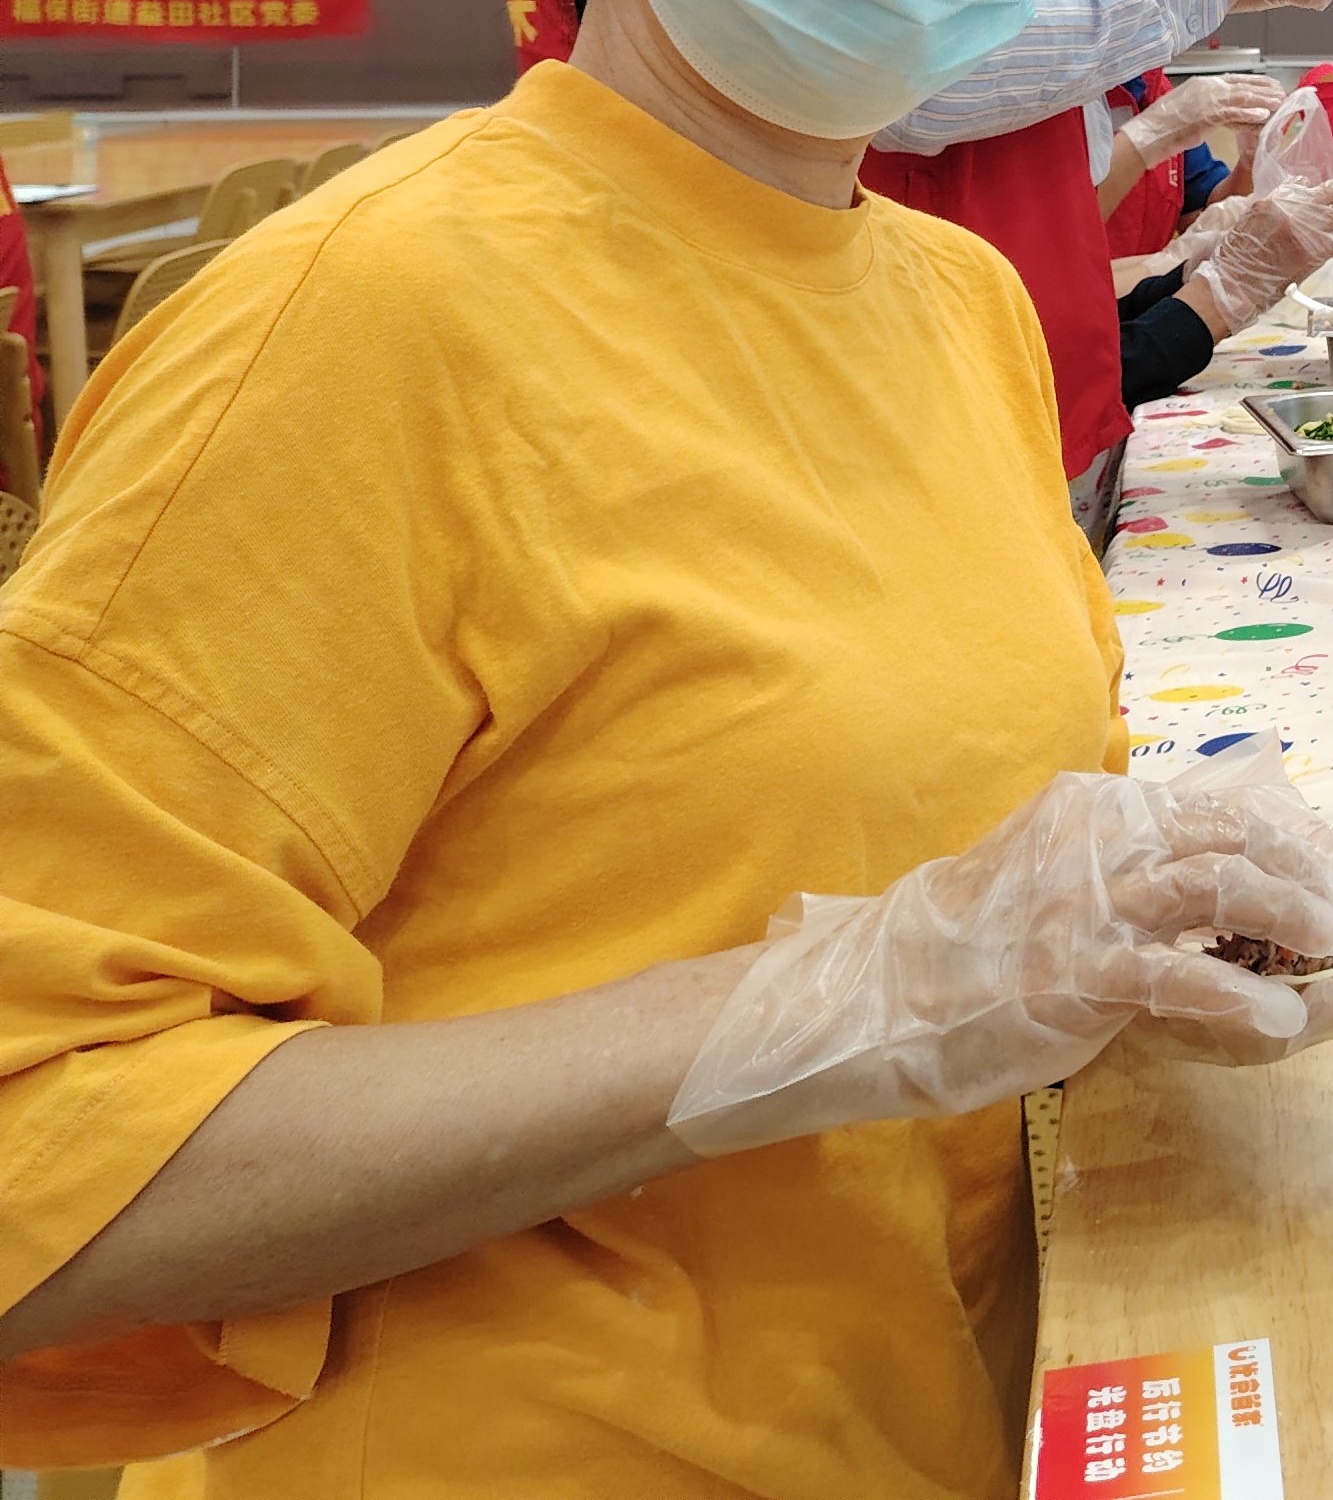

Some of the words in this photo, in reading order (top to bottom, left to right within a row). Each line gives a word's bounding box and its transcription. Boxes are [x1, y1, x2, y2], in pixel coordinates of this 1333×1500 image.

[1084, 1386, 1127, 1482] 光盘行动
[1141, 1376, 1184, 1473] 厉行节约
